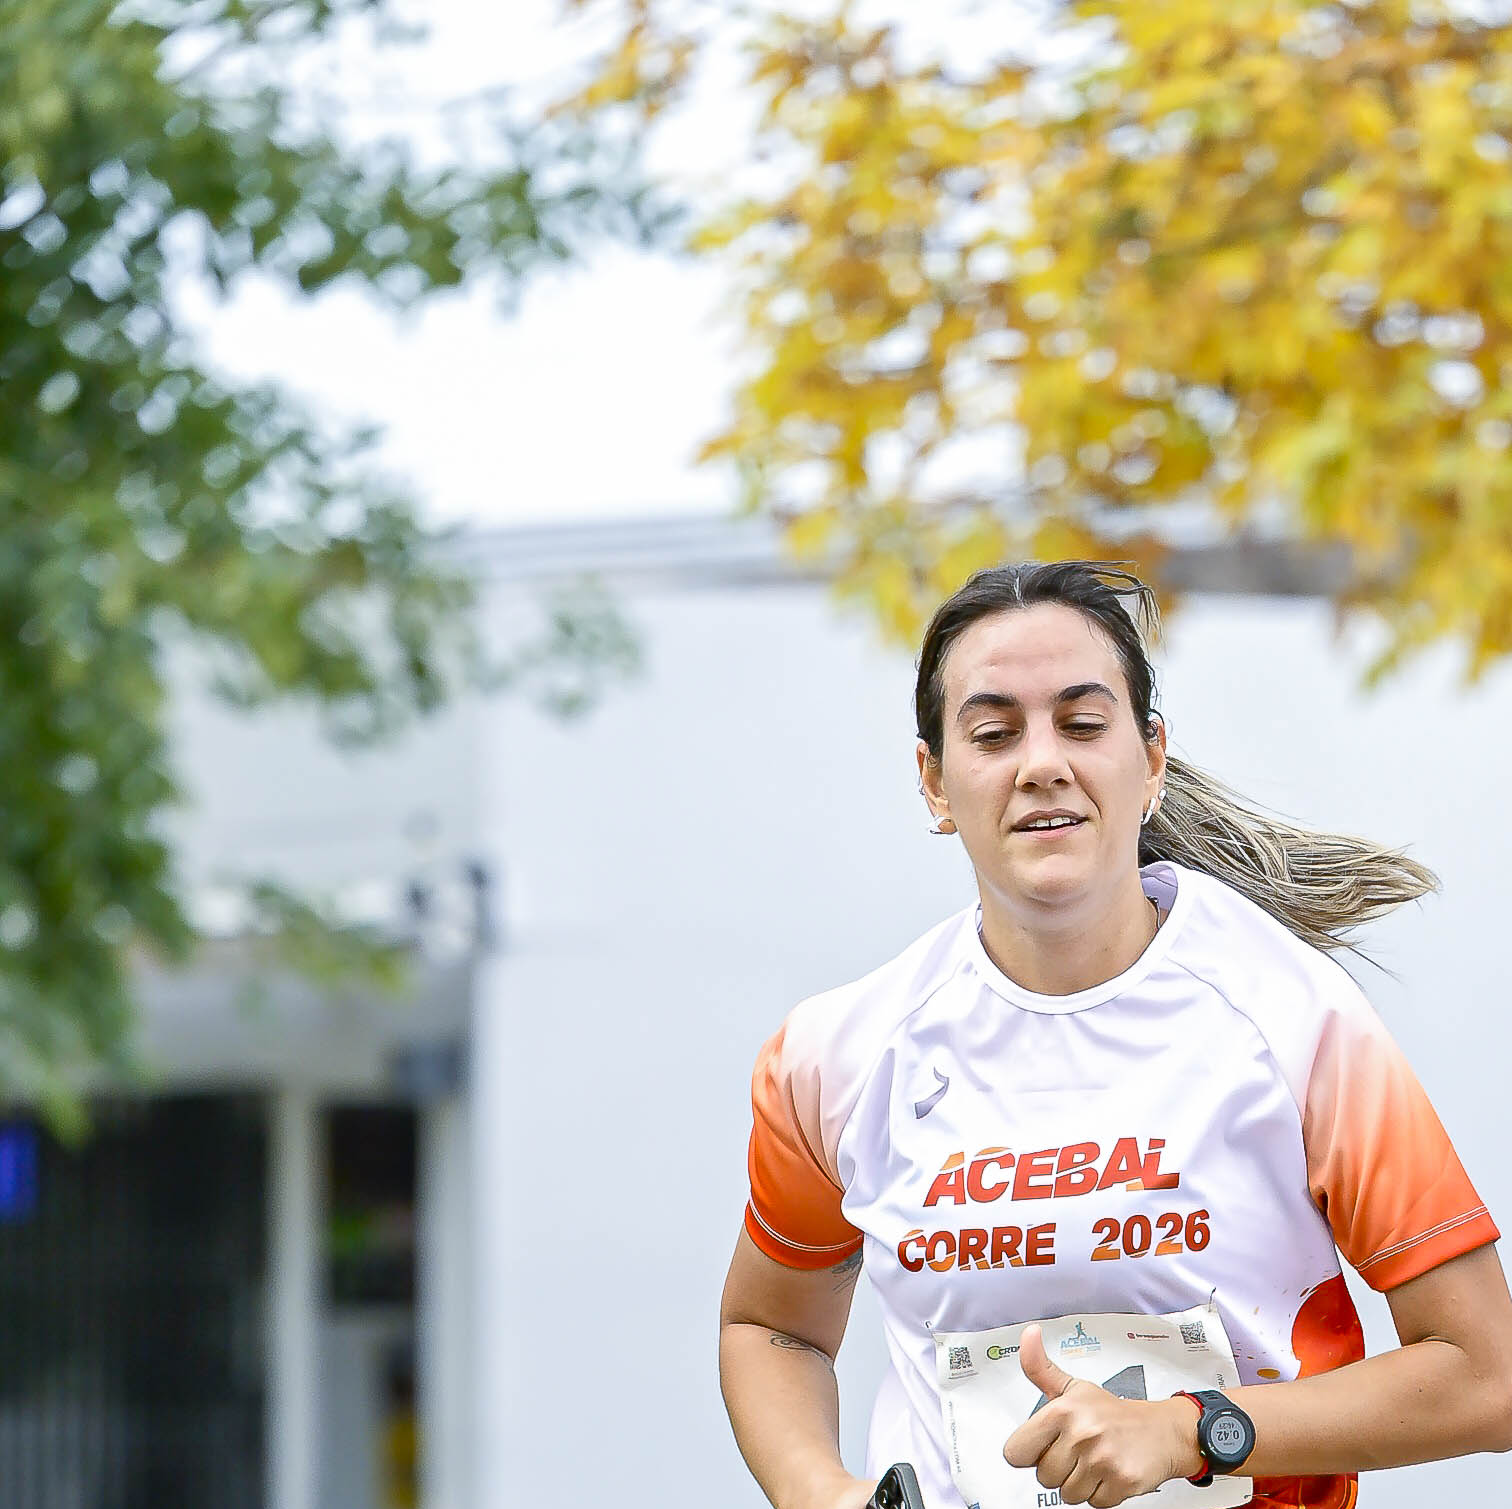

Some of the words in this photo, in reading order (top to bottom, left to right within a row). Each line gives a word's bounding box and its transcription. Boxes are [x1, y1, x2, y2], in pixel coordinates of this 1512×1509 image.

[923, 1137, 1180, 1207] ACEBAL
[897, 1222, 1056, 1272] CORRE
[1091, 1209, 1210, 1261] 2026
[1217, 1430, 1239, 1441] 0.42
[1037, 1489, 1062, 1507] FLO
